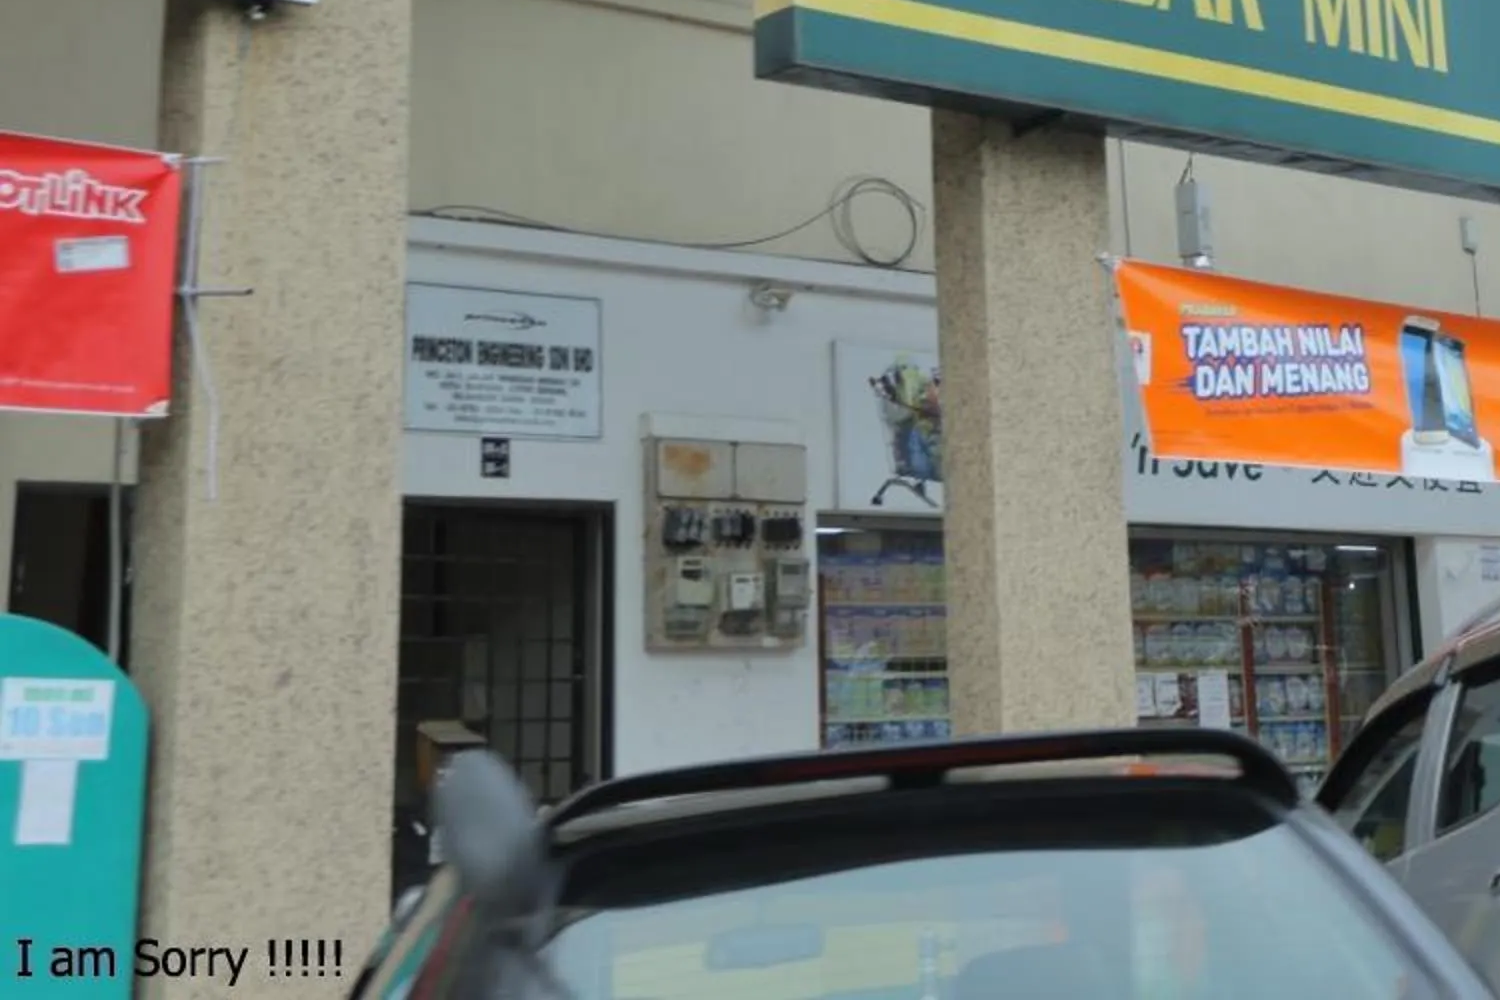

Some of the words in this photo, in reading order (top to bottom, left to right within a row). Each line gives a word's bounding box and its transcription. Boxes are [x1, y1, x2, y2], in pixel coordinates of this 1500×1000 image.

[1182, 326, 1297, 359] TAMBAH
[1298, 325, 1364, 357] NILAI
[1195, 365, 1254, 398] DAN
[1261, 362, 1370, 395] MENANG
